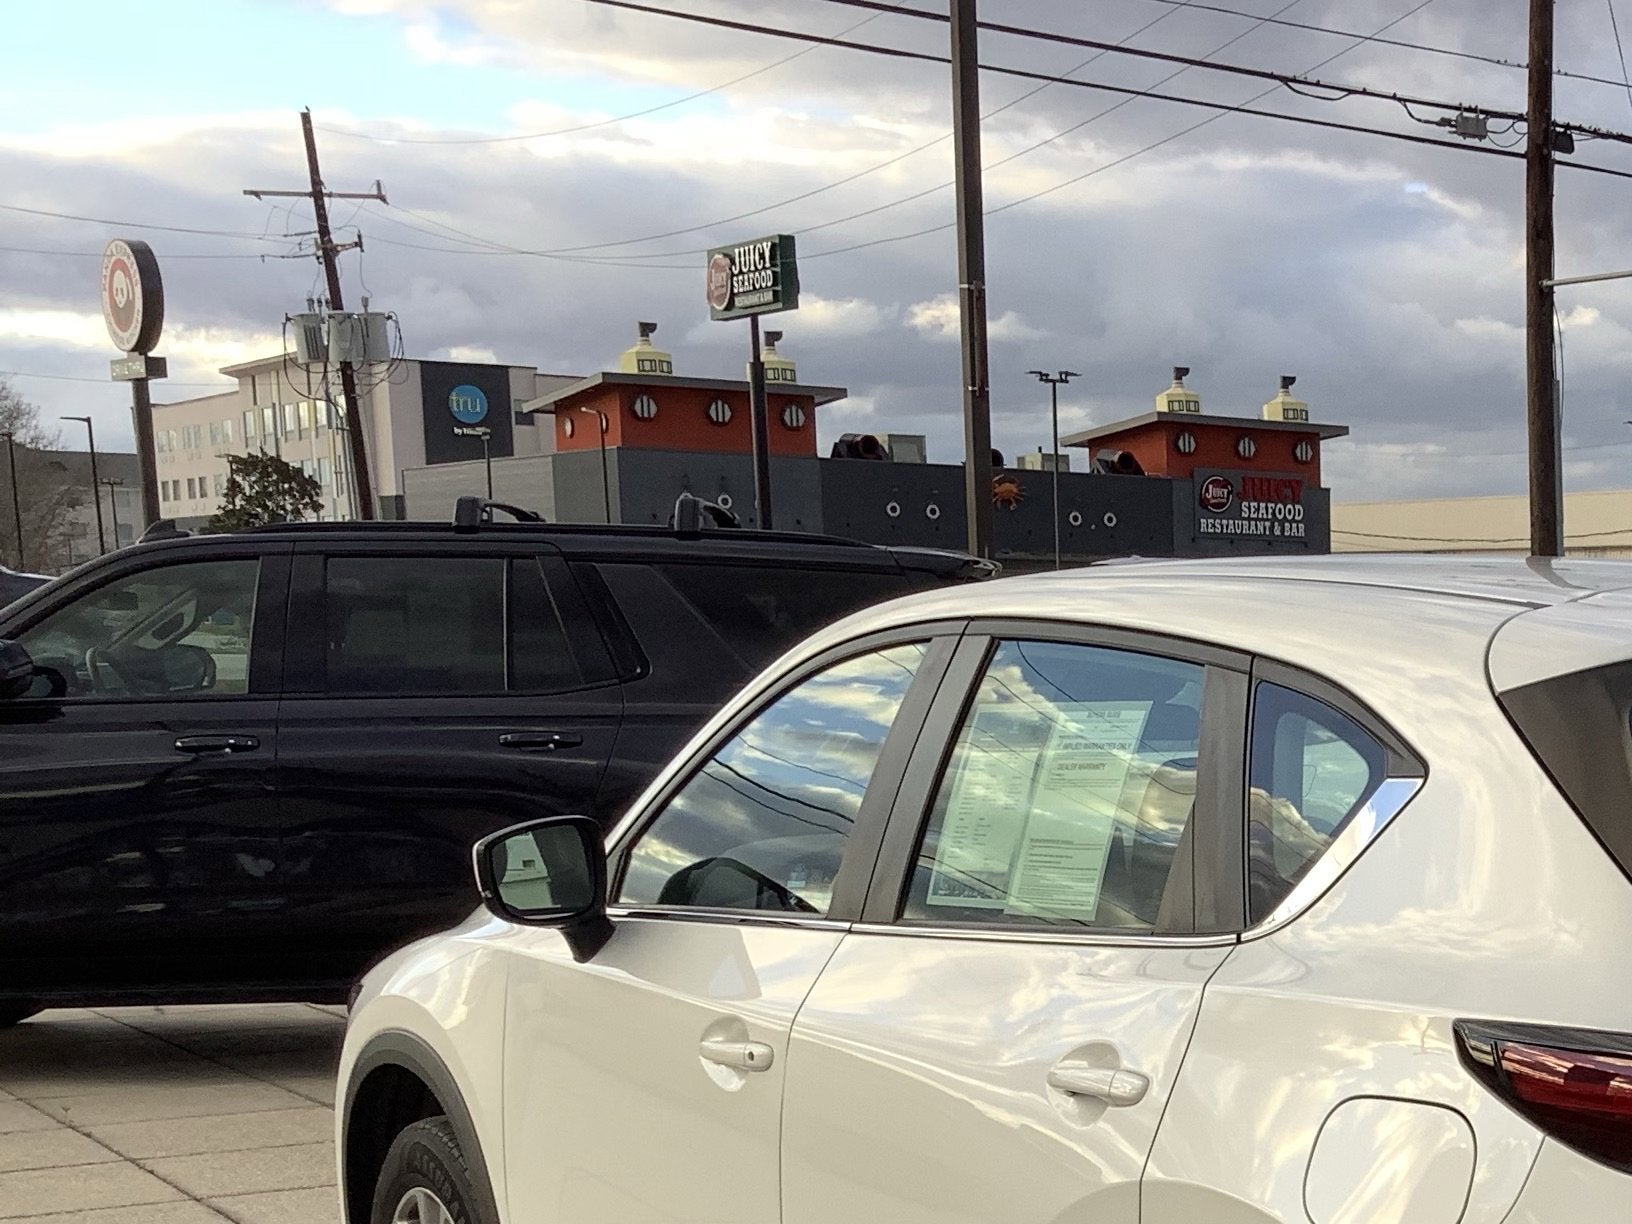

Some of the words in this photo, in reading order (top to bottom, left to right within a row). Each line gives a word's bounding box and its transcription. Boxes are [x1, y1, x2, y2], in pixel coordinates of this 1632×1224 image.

[731, 240, 772, 275] JUICY
[732, 269, 773, 294] SEAFOOD
[448, 391, 481, 413] tru
[1237, 477, 1302, 502] JUICY
[1241, 502, 1304, 520] SEAFOOD
[1200, 519, 1271, 536] RESTAURANT
[1273, 522, 1281, 536] &
[1284, 523, 1305, 537] BAR
